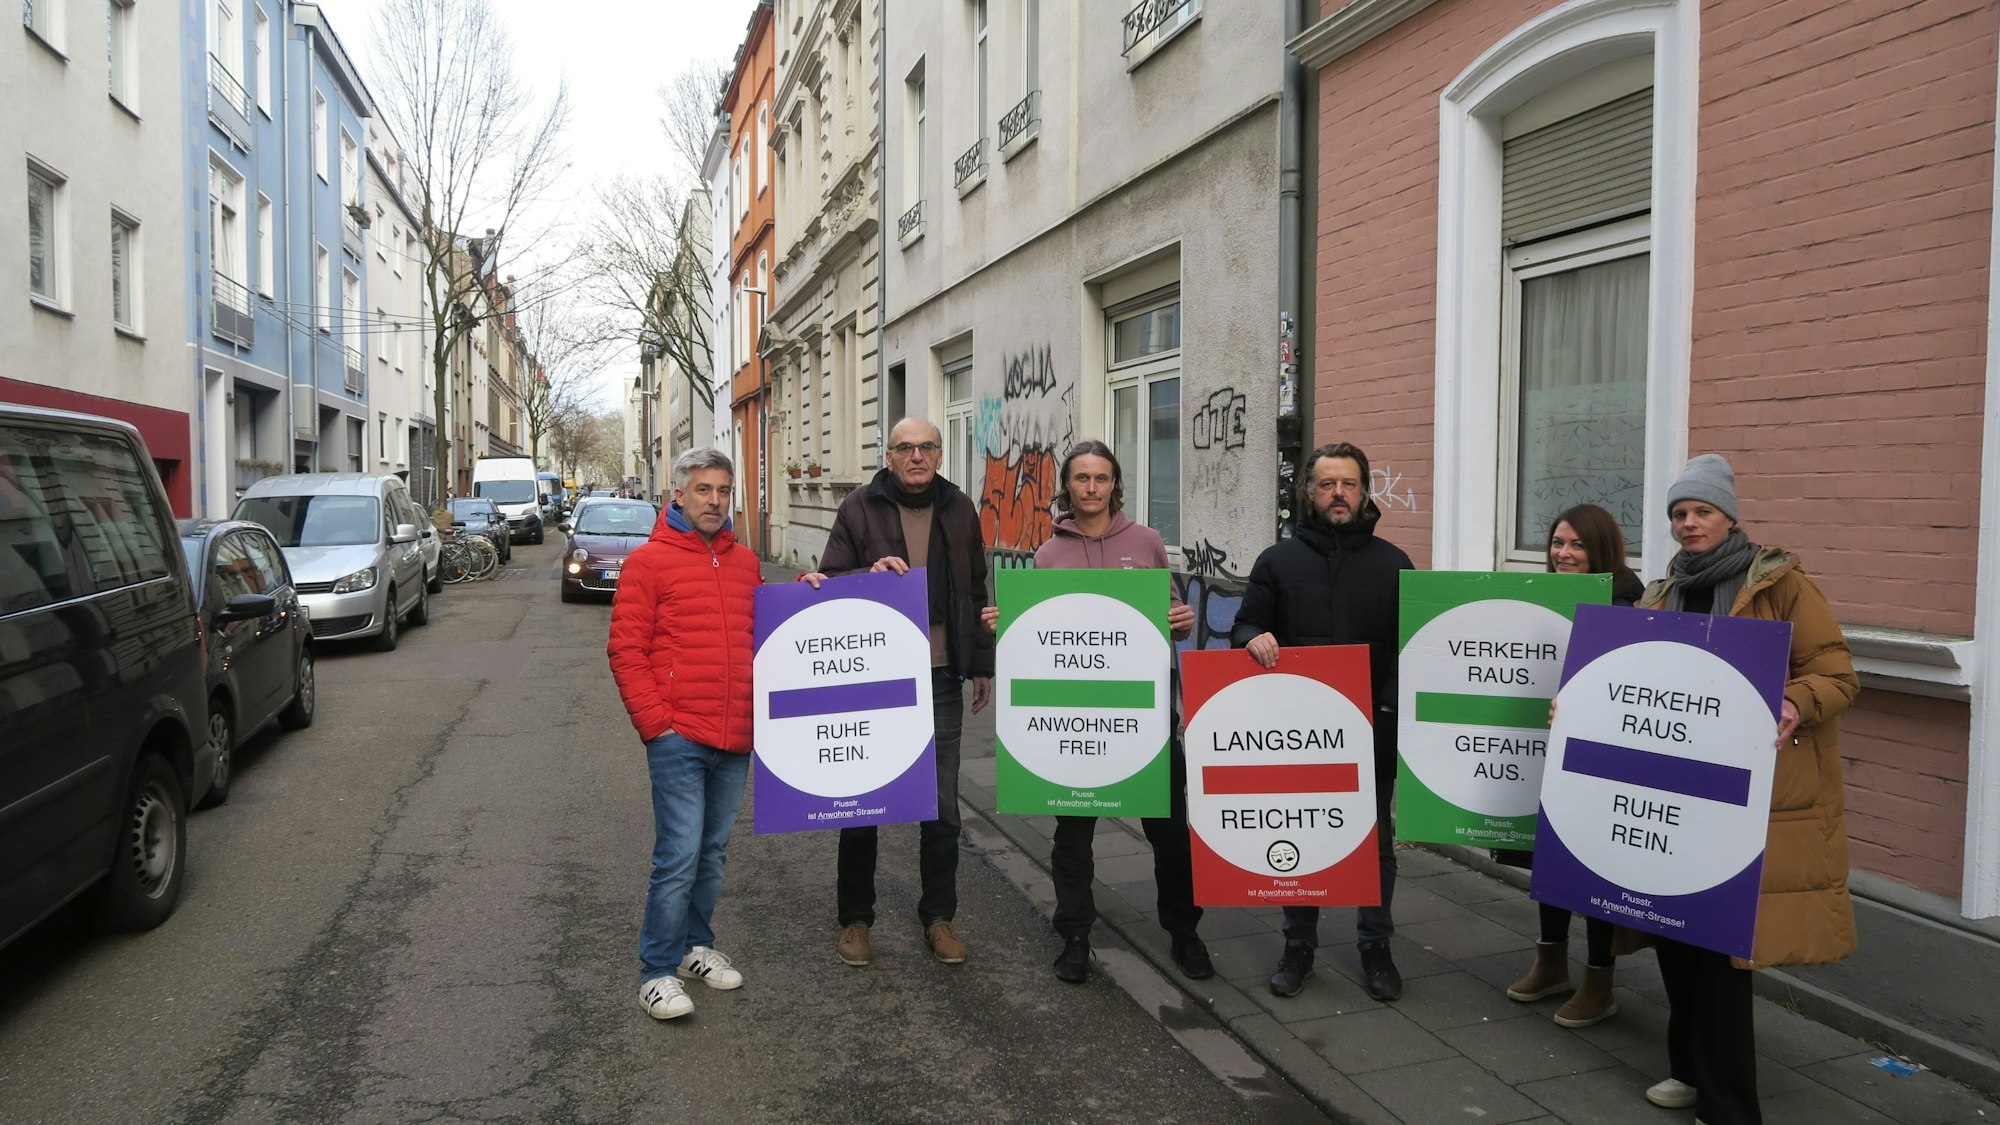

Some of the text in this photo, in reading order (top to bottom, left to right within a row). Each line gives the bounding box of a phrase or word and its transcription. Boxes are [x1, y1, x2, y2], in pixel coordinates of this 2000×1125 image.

[794, 631, 887, 655] VERKEHR
[1037, 630, 1128, 647] VERKEHR
[1447, 639, 1558, 661] VERKEHR
[812, 656, 871, 676] RAUS.
[1054, 653, 1111, 669] RAUS.
[1468, 666, 1536, 686] RAUS.
[1607, 682, 1722, 718] VERKEHR
[816, 720, 872, 741] RUHE
[1027, 717, 1139, 734] ANWOHNER
[1621, 714, 1693, 744] RAUS.
[1059, 740, 1107, 756] FREI!
[1212, 728, 1345, 752] LANGSAM
[1454, 735, 1547, 757] GEFAHR
[818, 744, 870, 764] REIN.
[1473, 762, 1526, 782] AUS.
[833, 799, 860, 808] Piusstr.
[1047, 799, 1122, 808] ist Anwohner-Strasse!
[1071, 790, 1097, 798] Piusstr.
[807, 806, 887, 820] ist Anwohner-Strasse!
[1221, 808, 1345, 830] REICHT'S
[1613, 794, 1682, 826] RUHE
[1455, 826, 1537, 840] ist Anwohner-Strass
[1484, 818, 1515, 829] Piusstr.
[1610, 823, 1674, 855] REIN.
[1247, 888, 1328, 897] ist Anwohner-Strasse!
[1273, 879, 1301, 887] Piusstr.
[1621, 891, 1654, 908] Piusstr.
[1590, 895, 1686, 929] ist Anwohner-Strasse!
